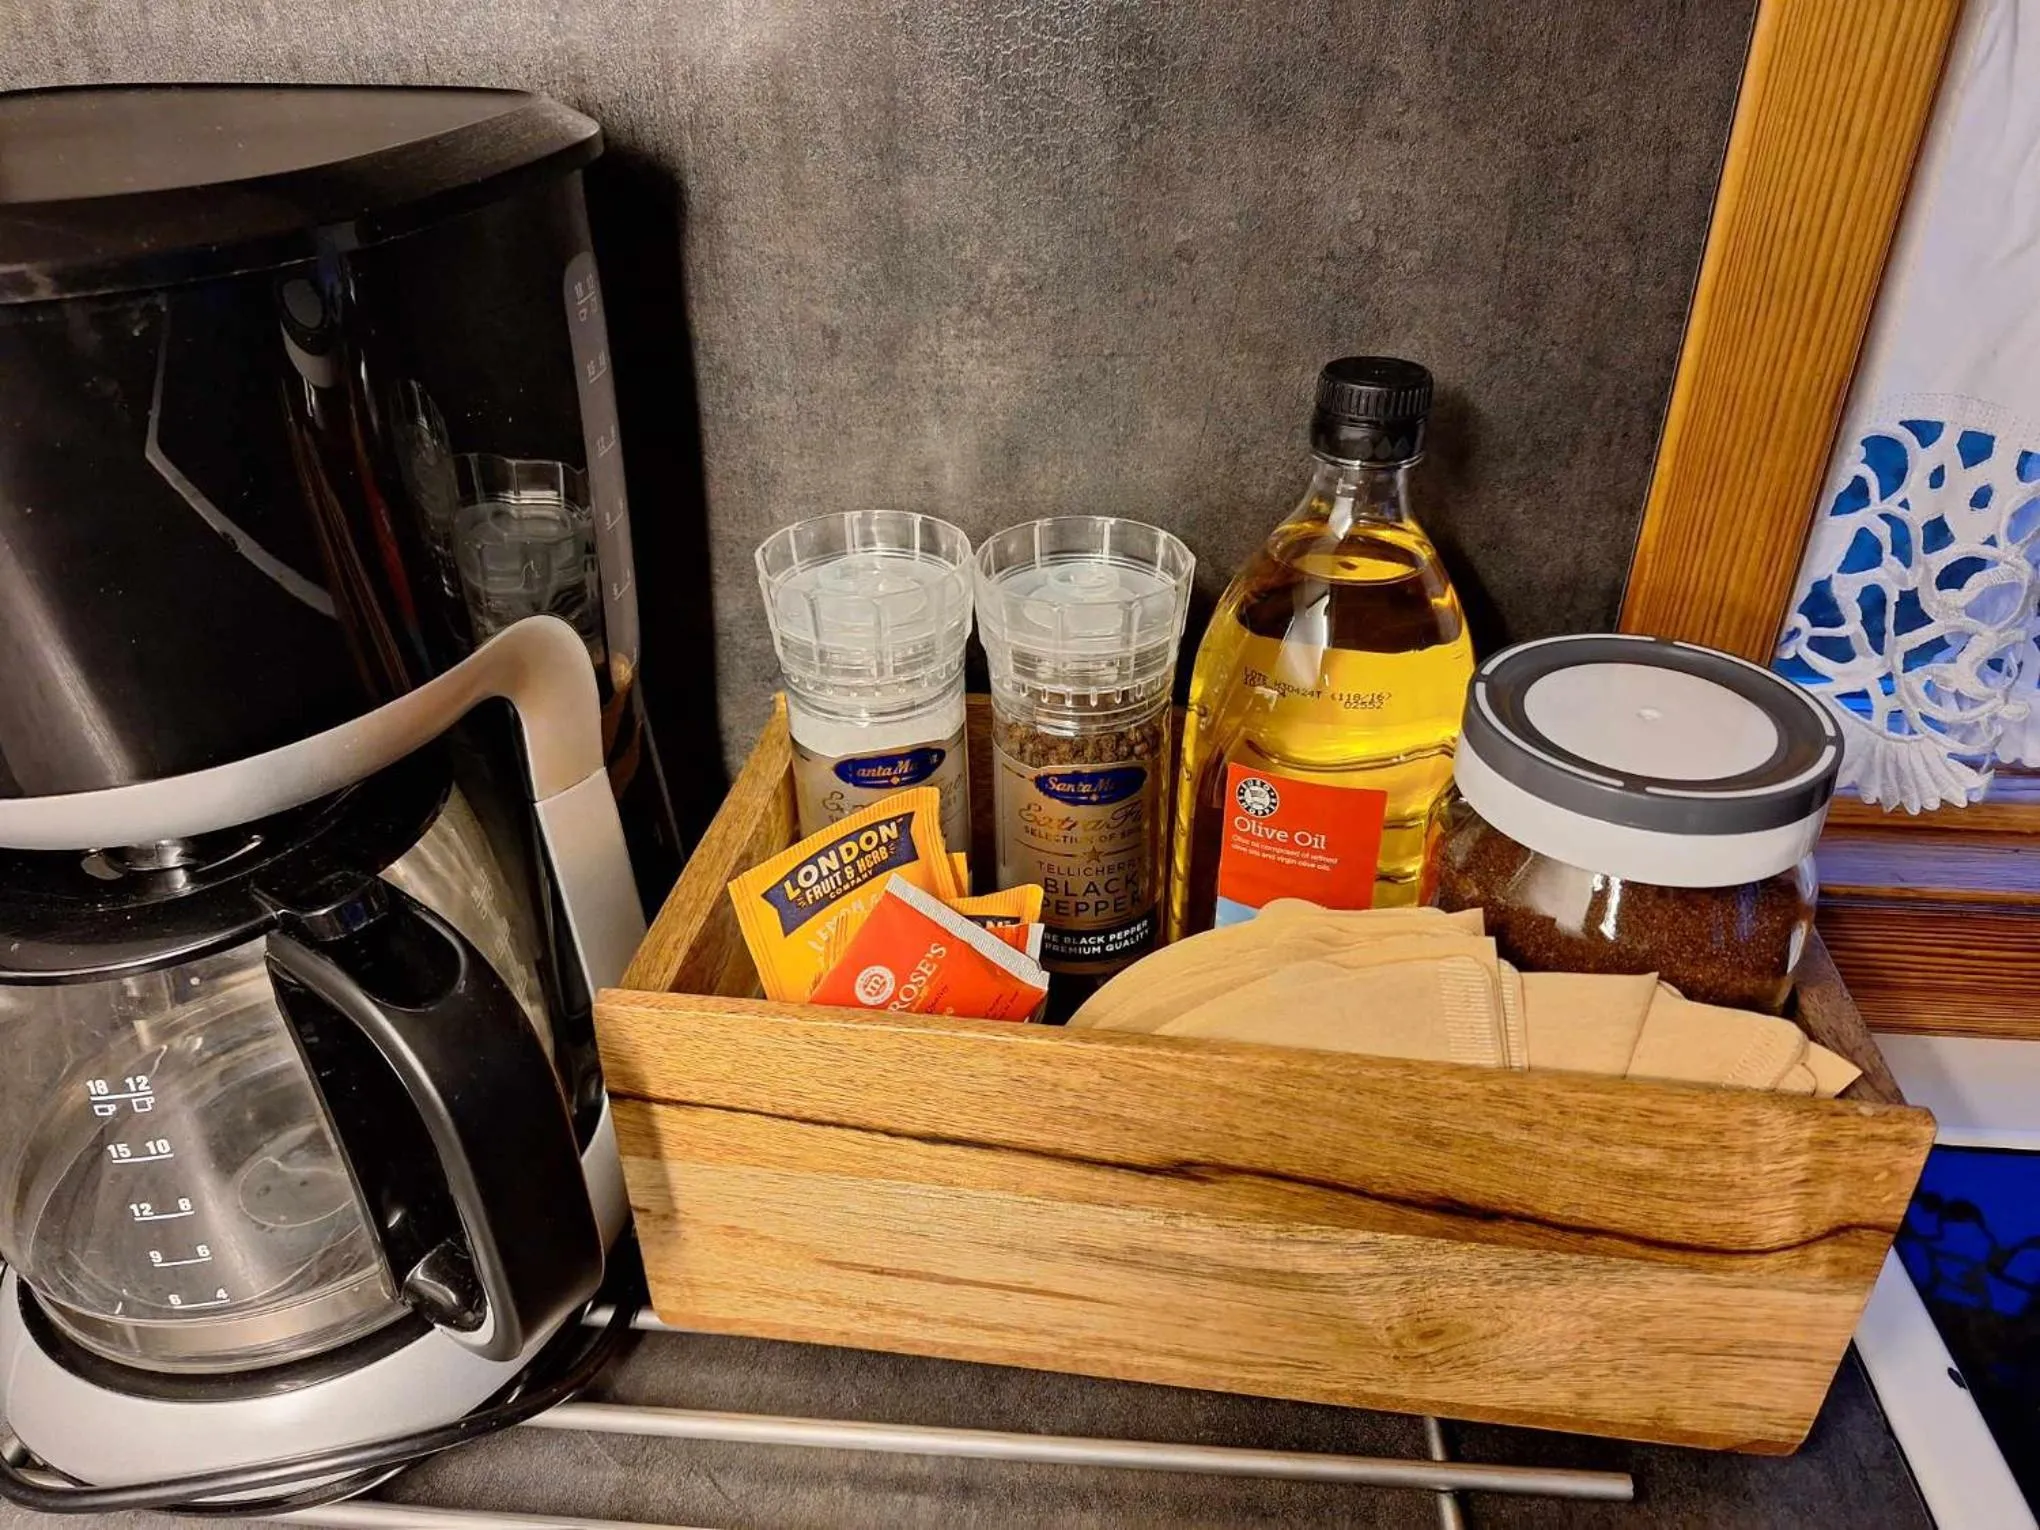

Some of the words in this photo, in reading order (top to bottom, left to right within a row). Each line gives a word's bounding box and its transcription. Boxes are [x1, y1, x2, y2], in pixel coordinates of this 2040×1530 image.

[1234, 815, 1289, 843] Olive
[1294, 831, 1327, 850] Oil
[783, 820, 899, 901] LONDON
[804, 870, 843, 906] FRUIT
[846, 865, 856, 881] &
[857, 846, 889, 872] HERB
[828, 869, 874, 900] COMPANY
[1043, 874, 1140, 897] BLACK
[1044, 941, 1101, 956] PREMIUM
[1104, 928, 1150, 953] QUALITY
[1063, 933, 1105, 946] BLACK
[1108, 919, 1149, 943] PEPPER
[86, 1079, 109, 1096] 18
[125, 1075, 151, 1092] 12
[107, 1142, 132, 1159] 15
[145, 1138, 171, 1155] 10
[129, 1202, 155, 1217] 12
[178, 1197, 192, 1212] 8
[149, 1250, 163, 1264] 9
[216, 1287, 229, 1300] 4
